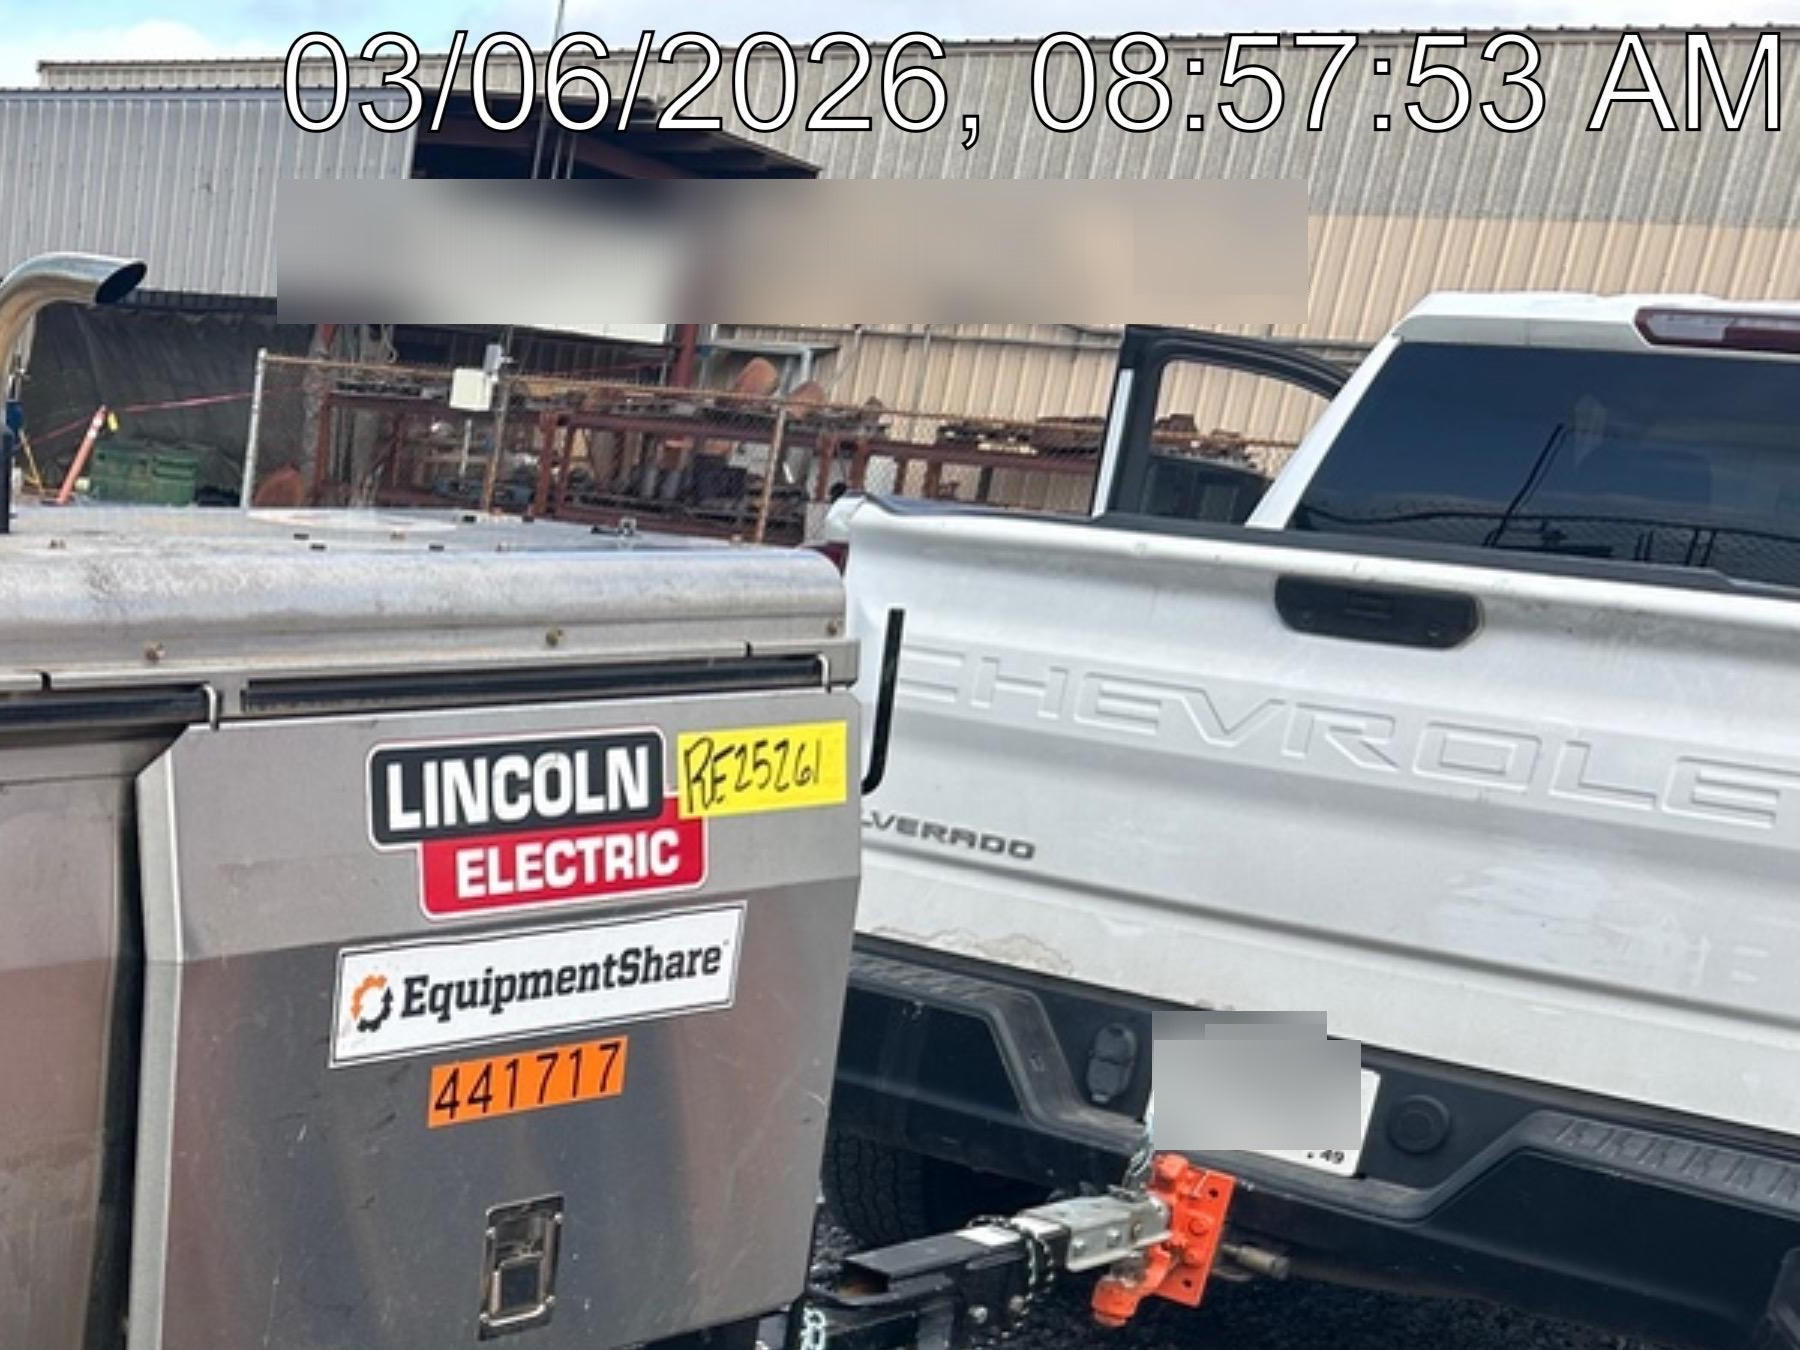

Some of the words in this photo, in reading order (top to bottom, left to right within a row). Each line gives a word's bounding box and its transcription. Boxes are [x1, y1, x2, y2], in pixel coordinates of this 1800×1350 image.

[900, 644, 1800, 828] CHEVROLE
[386, 745, 649, 831] LINCOLN
[457, 829, 680, 898] ELECTRIC
[401, 944, 722, 1024] EquipmentShare
[434, 1044, 621, 1120] 441717
